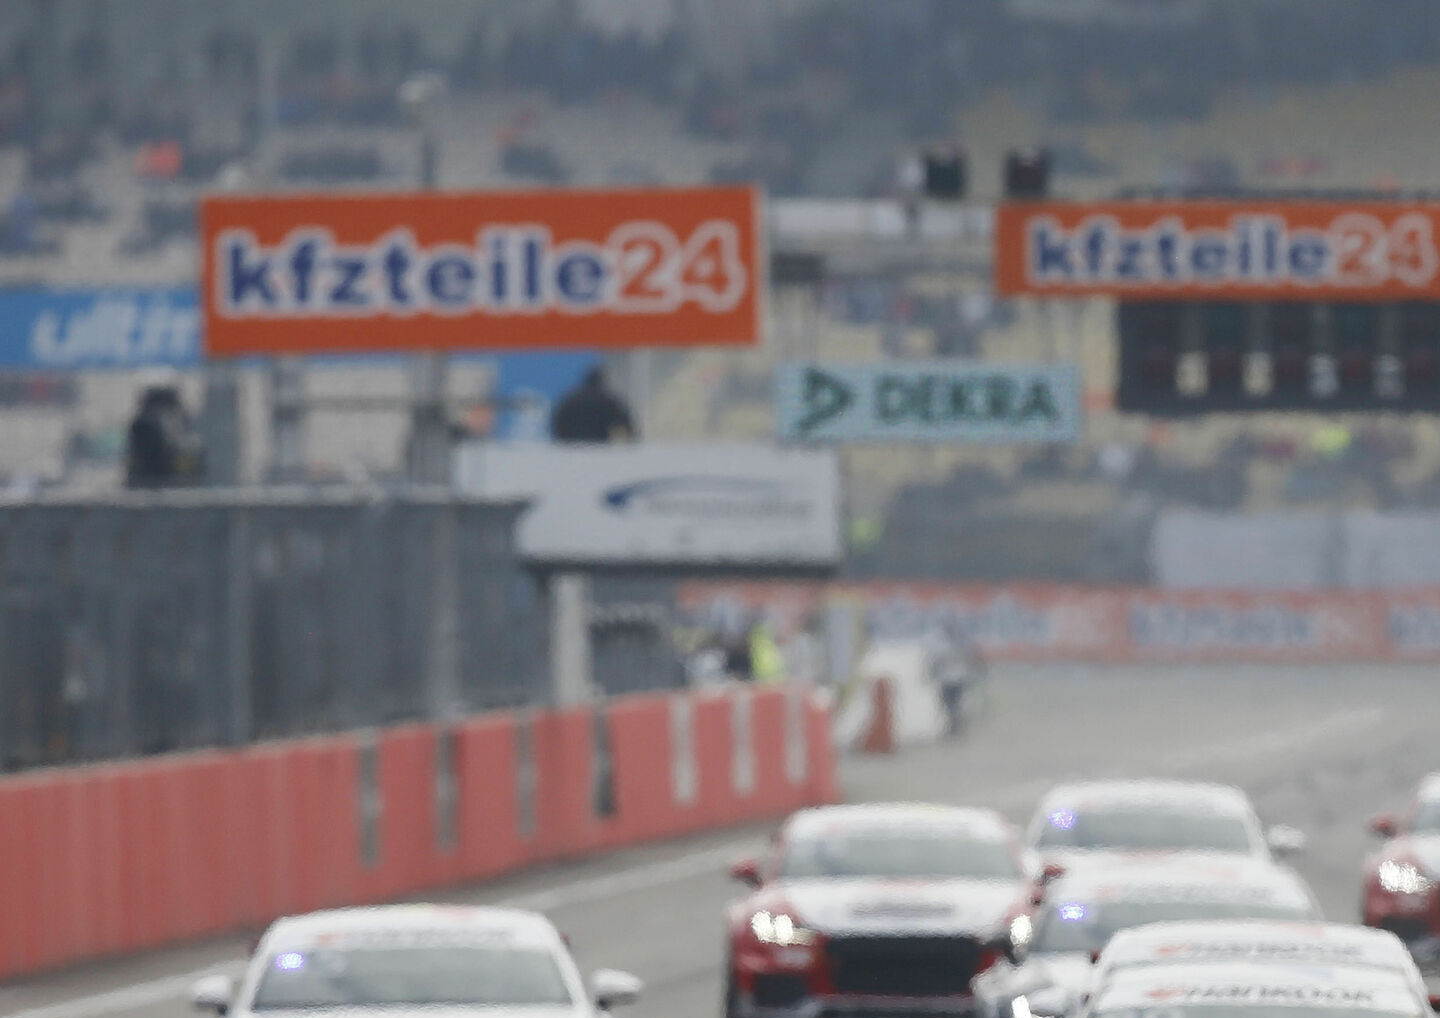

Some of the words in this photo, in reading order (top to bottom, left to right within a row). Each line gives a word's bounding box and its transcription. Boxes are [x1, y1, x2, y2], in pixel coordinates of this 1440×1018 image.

[215, 221, 747, 318] kfzteile24
[1026, 214, 1440, 291] kfzteile24
[873, 374, 1059, 423] DEKRA
